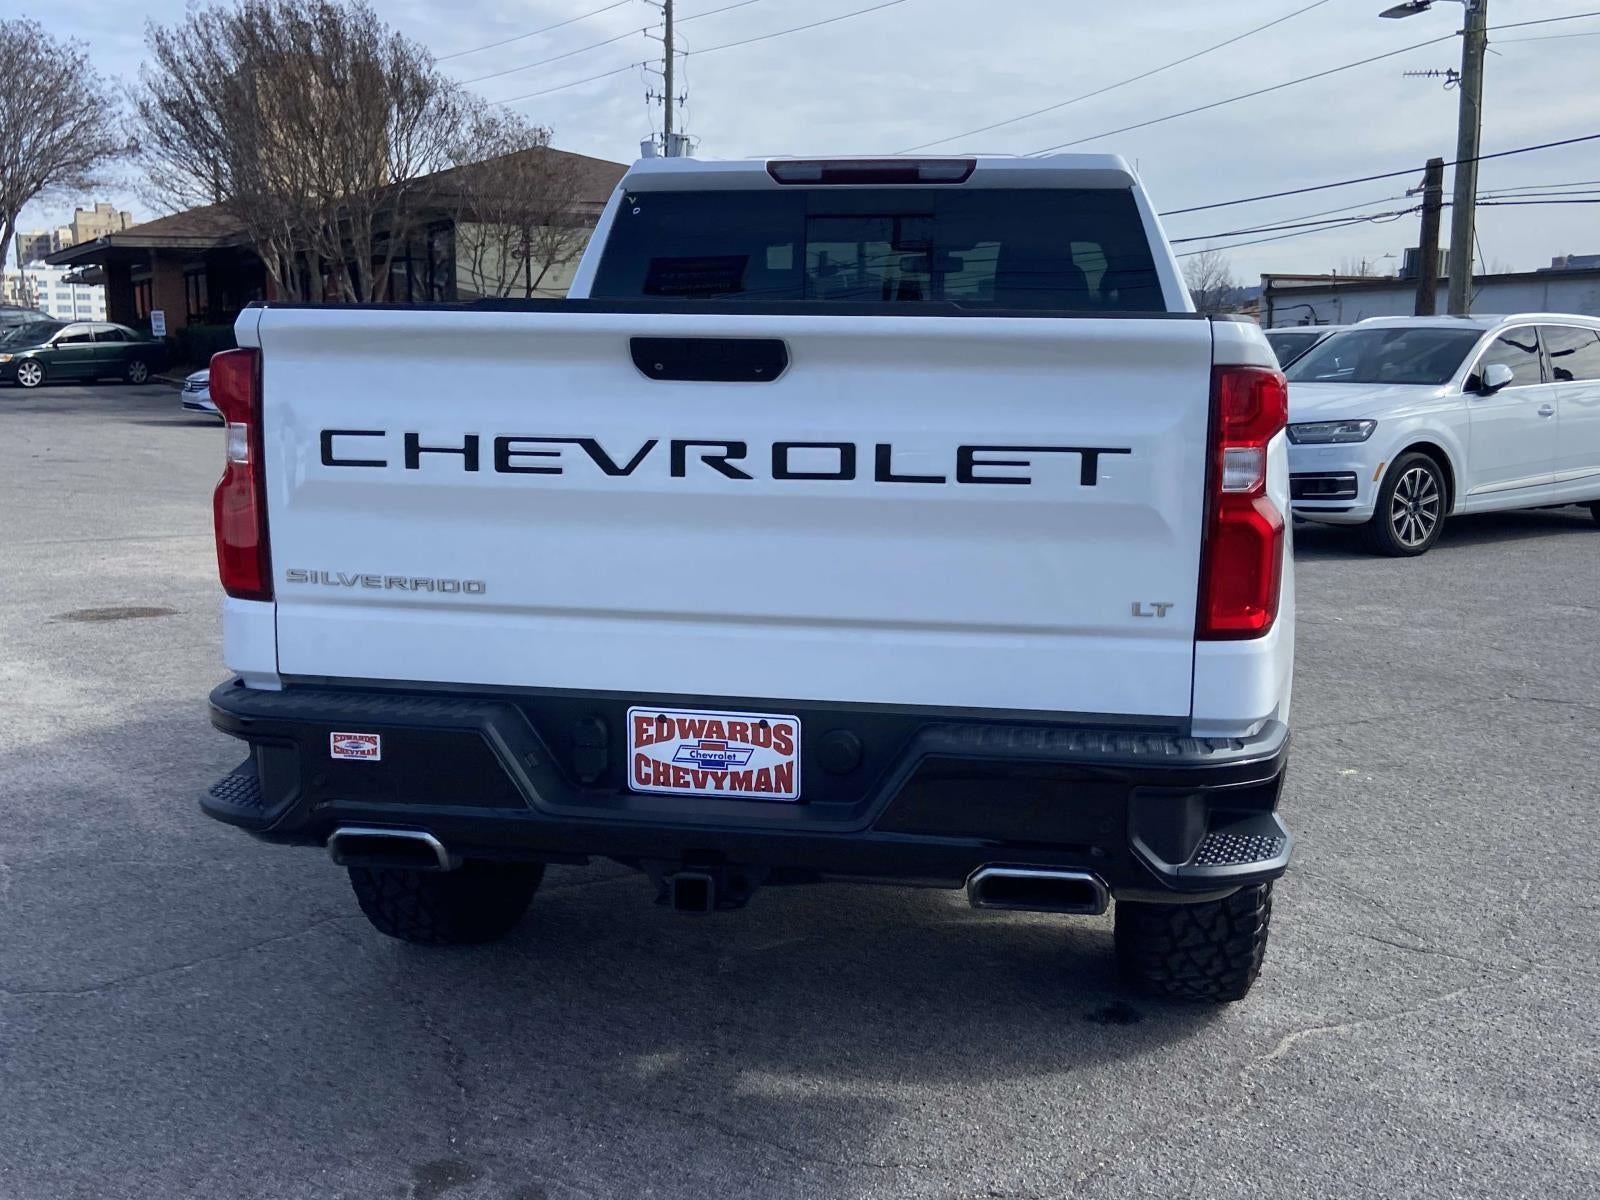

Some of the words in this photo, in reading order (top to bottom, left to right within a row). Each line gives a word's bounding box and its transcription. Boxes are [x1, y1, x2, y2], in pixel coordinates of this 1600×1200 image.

[320, 429, 1132, 486] CHEVROLET
[286, 568, 486, 594] SILVERADO
[1131, 601, 1174, 618] LT
[634, 715, 794, 756] EDWARDS
[689, 749, 737, 761] Chevrolet
[634, 752, 794, 794] CHEVYMAN
